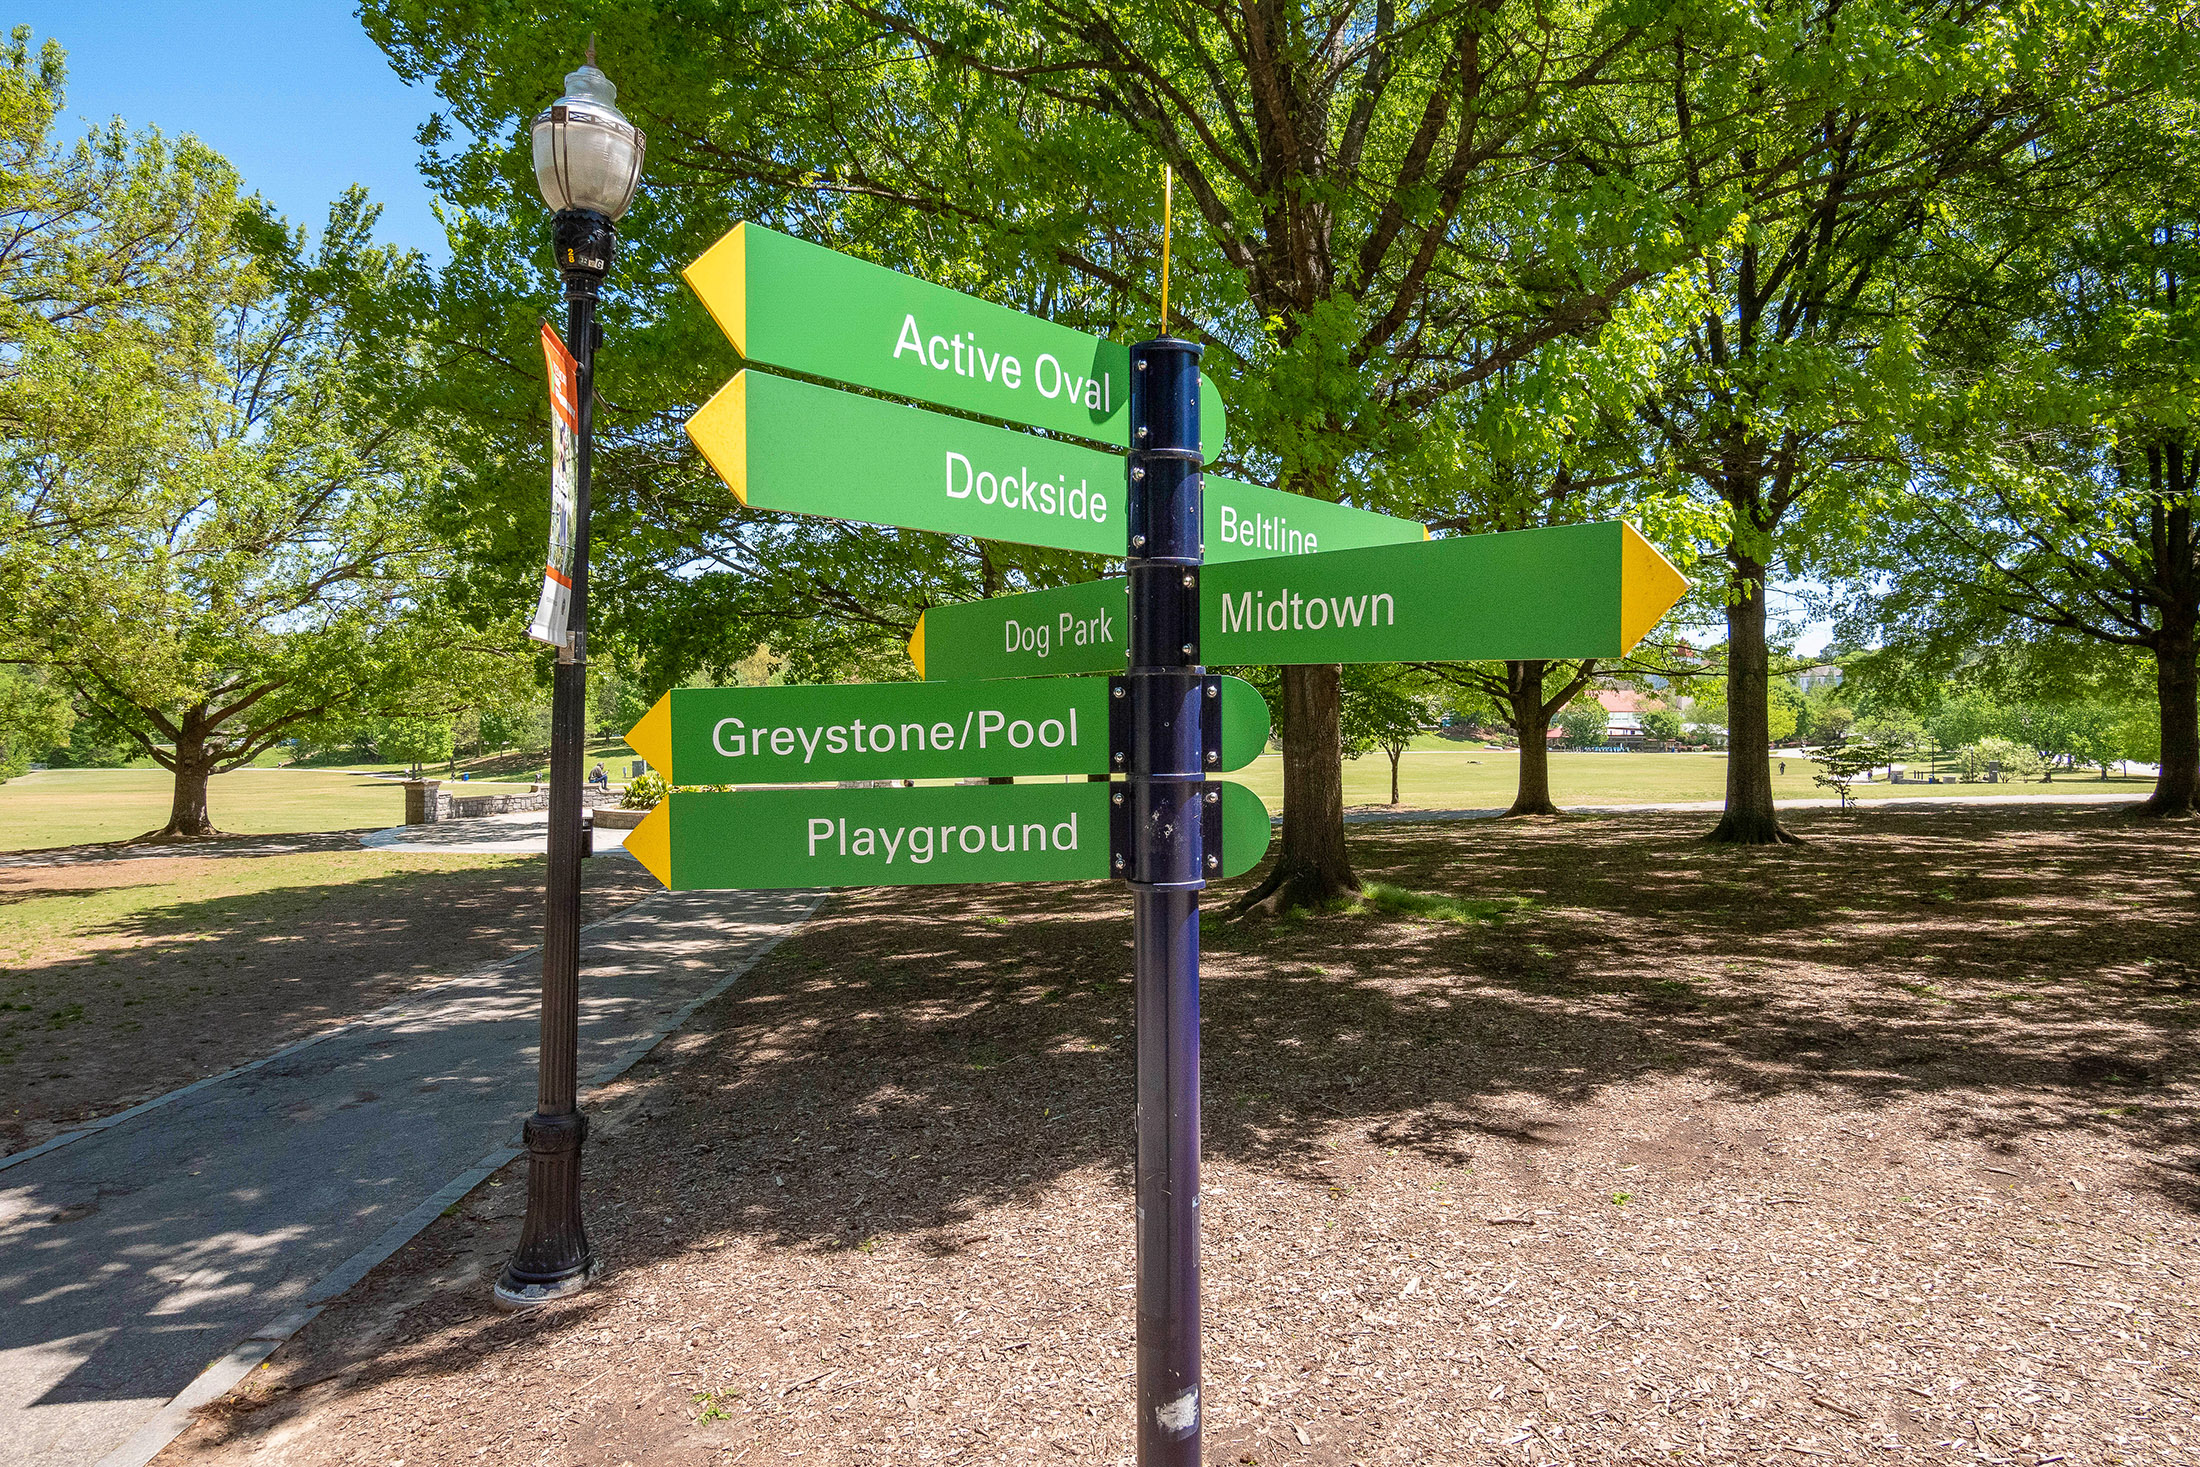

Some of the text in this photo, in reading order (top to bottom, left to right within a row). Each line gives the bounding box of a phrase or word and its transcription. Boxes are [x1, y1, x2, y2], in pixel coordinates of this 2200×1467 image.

[893, 313, 1110, 413] Active Oval
[946, 451, 1108, 523] Dockside
[1221, 505, 1318, 555] Beltline
[1005, 607, 1114, 658] Dog Park
[1222, 589, 1394, 633] Midtown
[712, 708, 1078, 763] Greystone/Pool
[808, 812, 1078, 864] Playground
